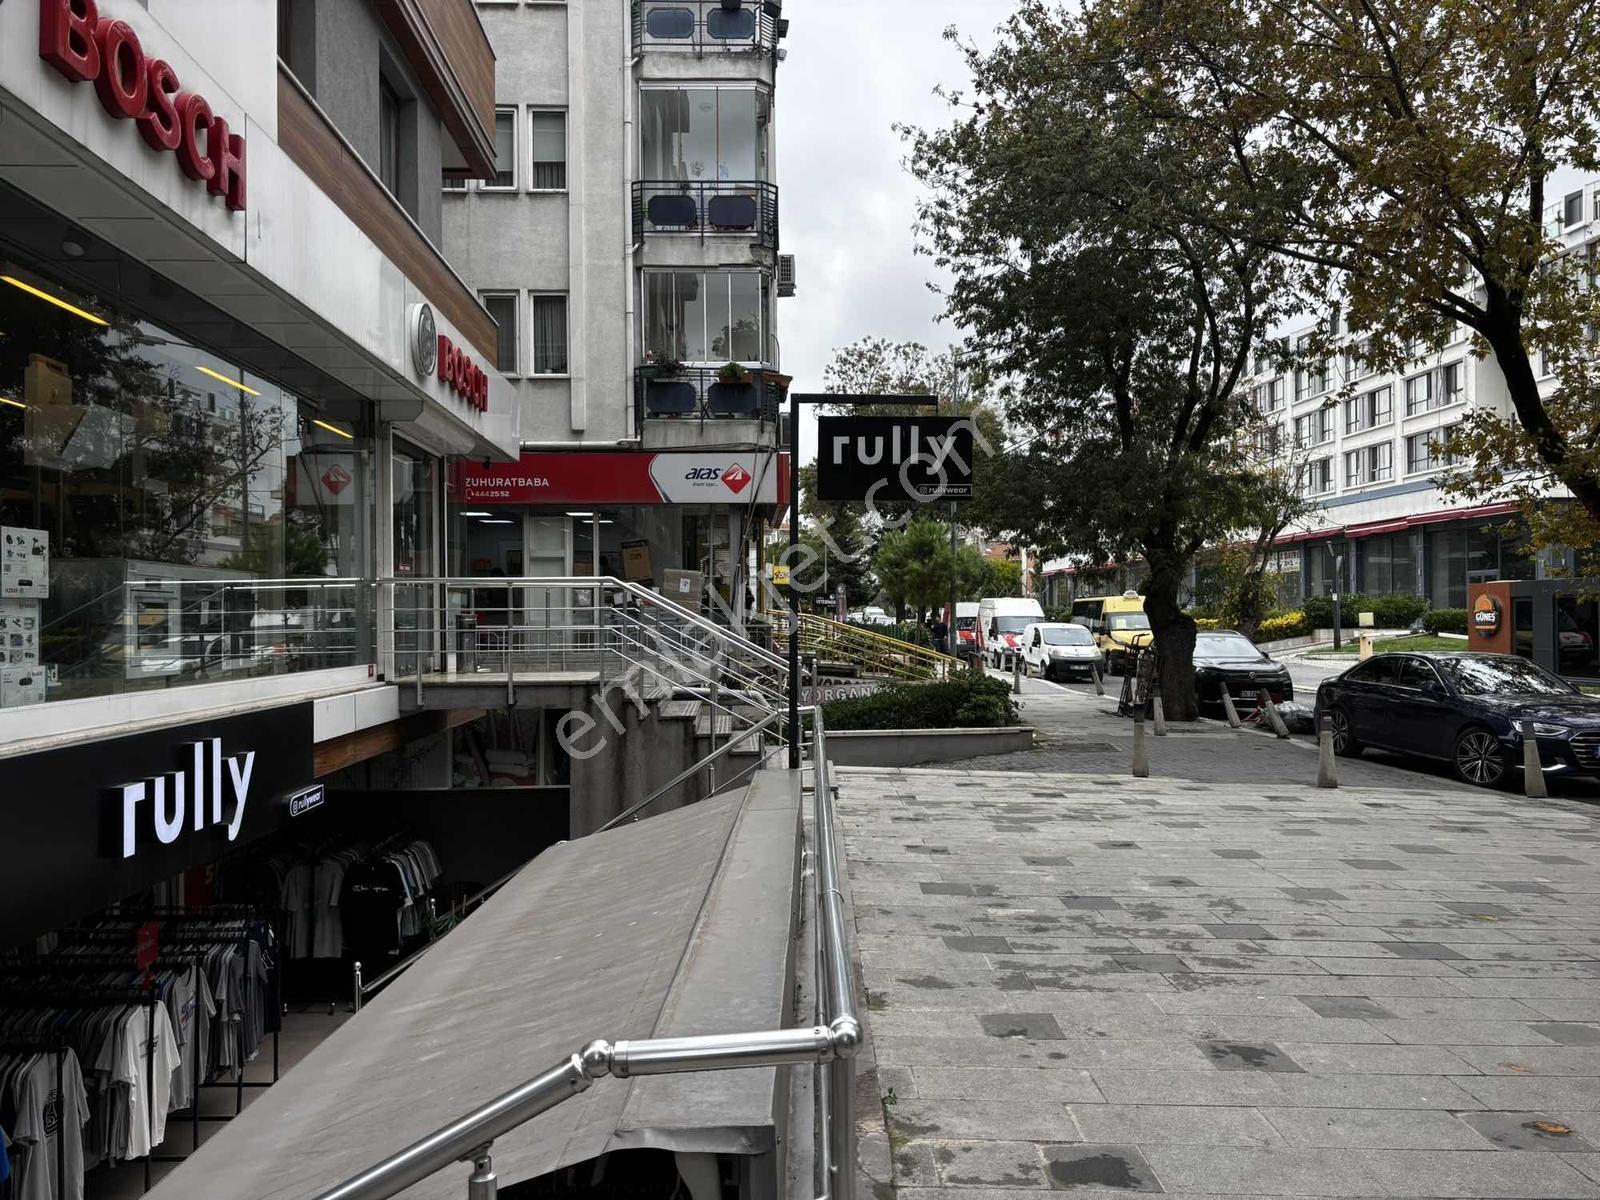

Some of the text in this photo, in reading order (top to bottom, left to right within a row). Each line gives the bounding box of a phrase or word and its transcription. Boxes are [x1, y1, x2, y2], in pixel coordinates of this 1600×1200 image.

[39, 0, 247, 211] BOSCH
[437, 335, 488, 412] BOSCH
[465, 477, 549, 487] ZUHURATBABA
[685, 467, 721, 480] aras
[833, 425, 957, 476] rully
[123, 737, 256, 859] rully
